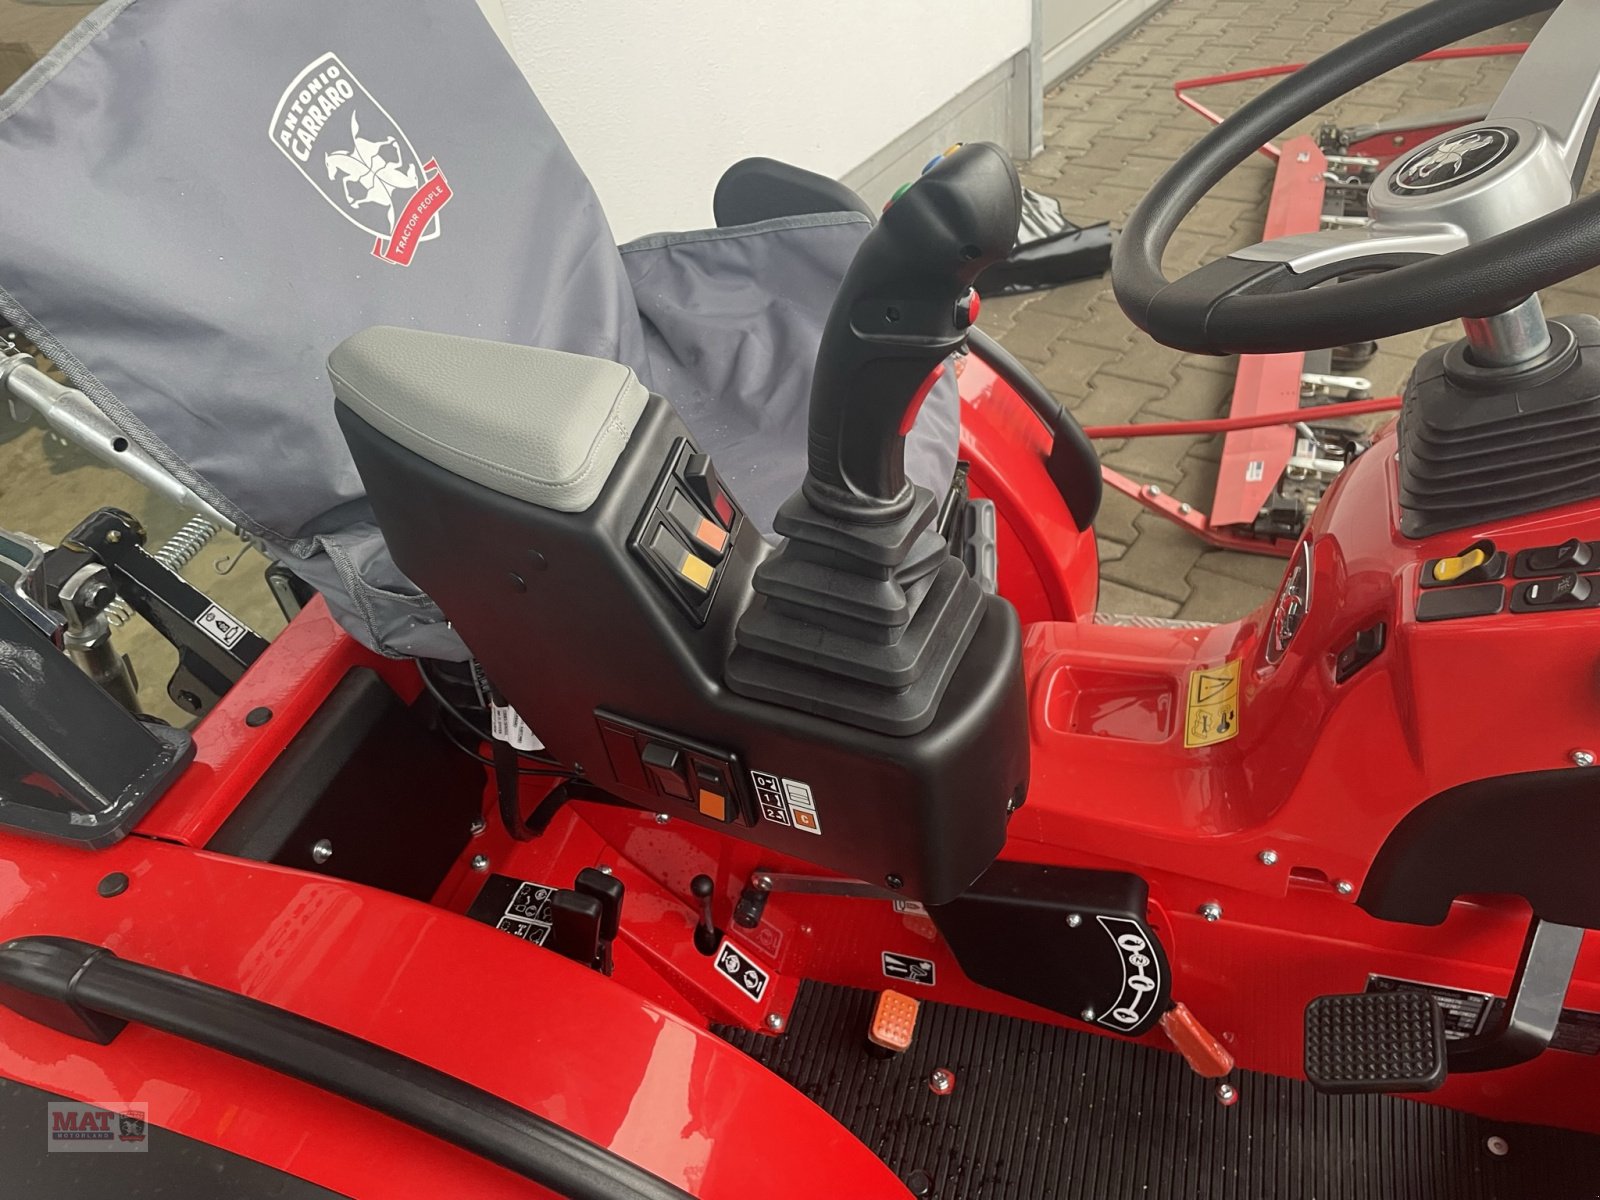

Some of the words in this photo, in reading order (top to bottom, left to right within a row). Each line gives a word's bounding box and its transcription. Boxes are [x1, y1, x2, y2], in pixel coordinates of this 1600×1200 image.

[280, 65, 341, 147] ANTONIO
[291, 79, 354, 162] CARRARO
[395, 213, 420, 255] TRACTOR
[417, 185, 444, 214] PEOPLE
[767, 809, 775, 818] 2
[801, 814, 809, 824] C
